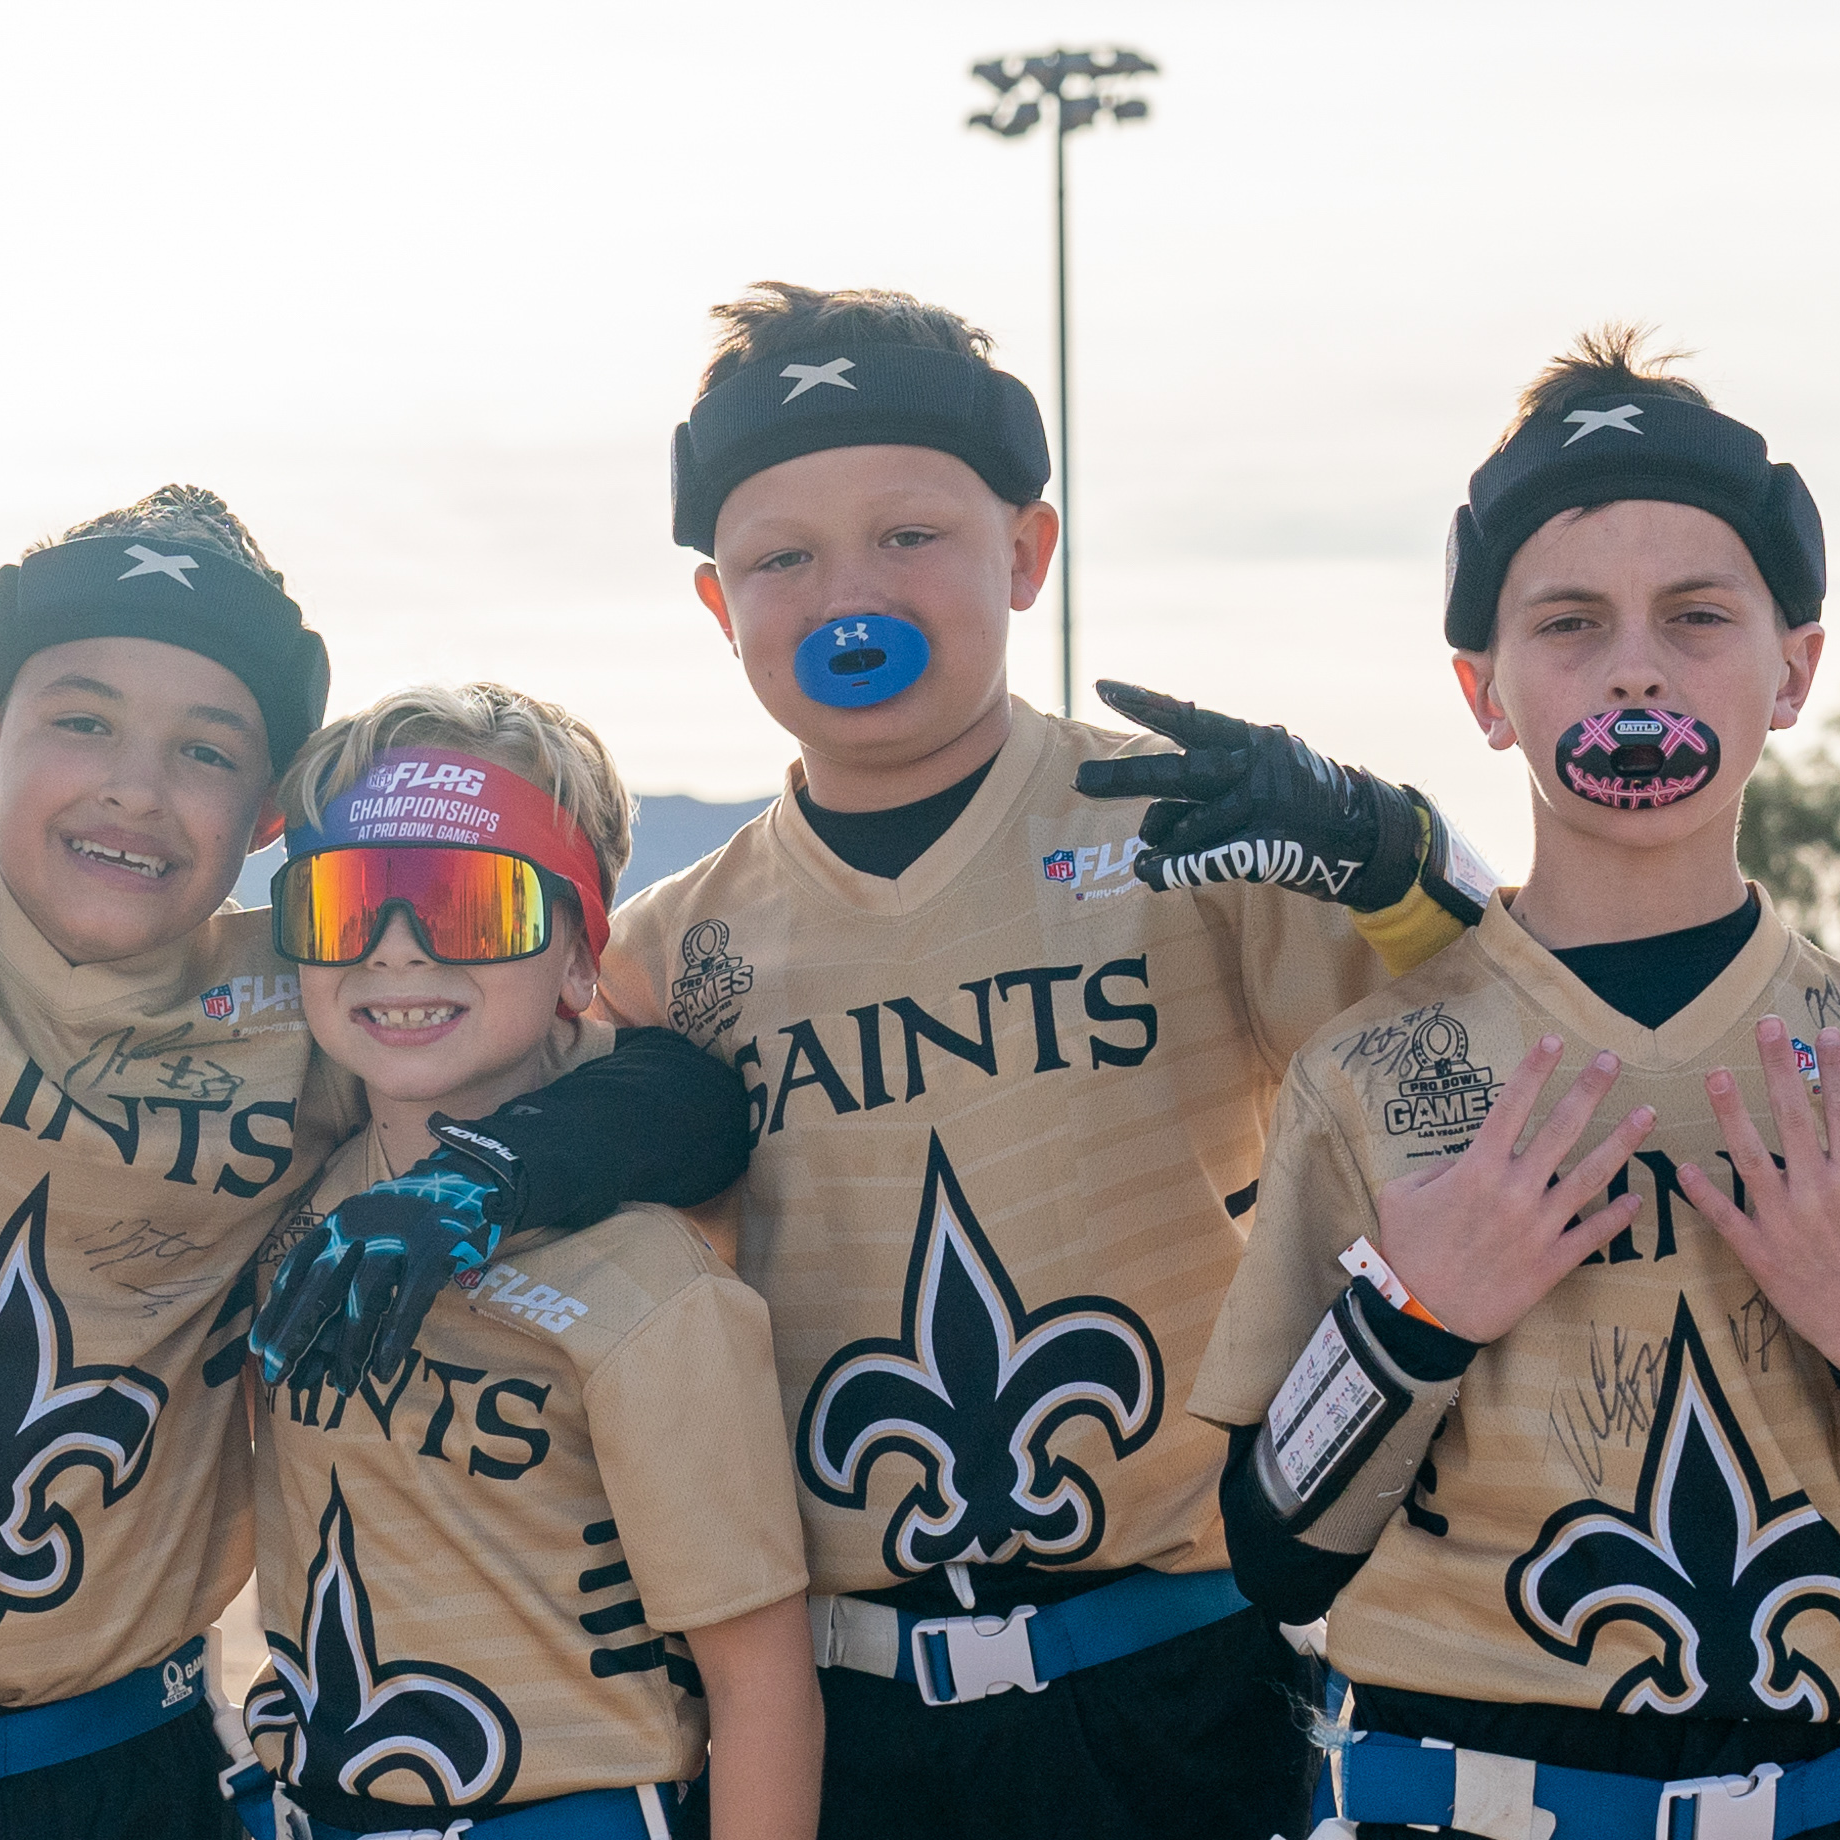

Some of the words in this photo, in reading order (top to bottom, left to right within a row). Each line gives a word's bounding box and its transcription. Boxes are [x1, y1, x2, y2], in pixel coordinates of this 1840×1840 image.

[1616, 722, 1662, 733] BATTLE
[385, 762, 486, 796] FLAG
[349, 797, 500, 832] CHAMPIONSHIPS
[358, 824, 373, 840] AT
[373, 823, 397, 837] PRO
[398, 822, 434, 838] BOWL
[436, 825, 479, 845] GAMES
[1047, 862, 1073, 878] NFL
[206, 997, 231, 1015] NFL
[668, 965, 754, 1035] GAMES
[1410, 1081, 1437, 1092] PRO
[1442, 1074, 1482, 1090] BOWL
[467, 1263, 589, 1334] FLAG
